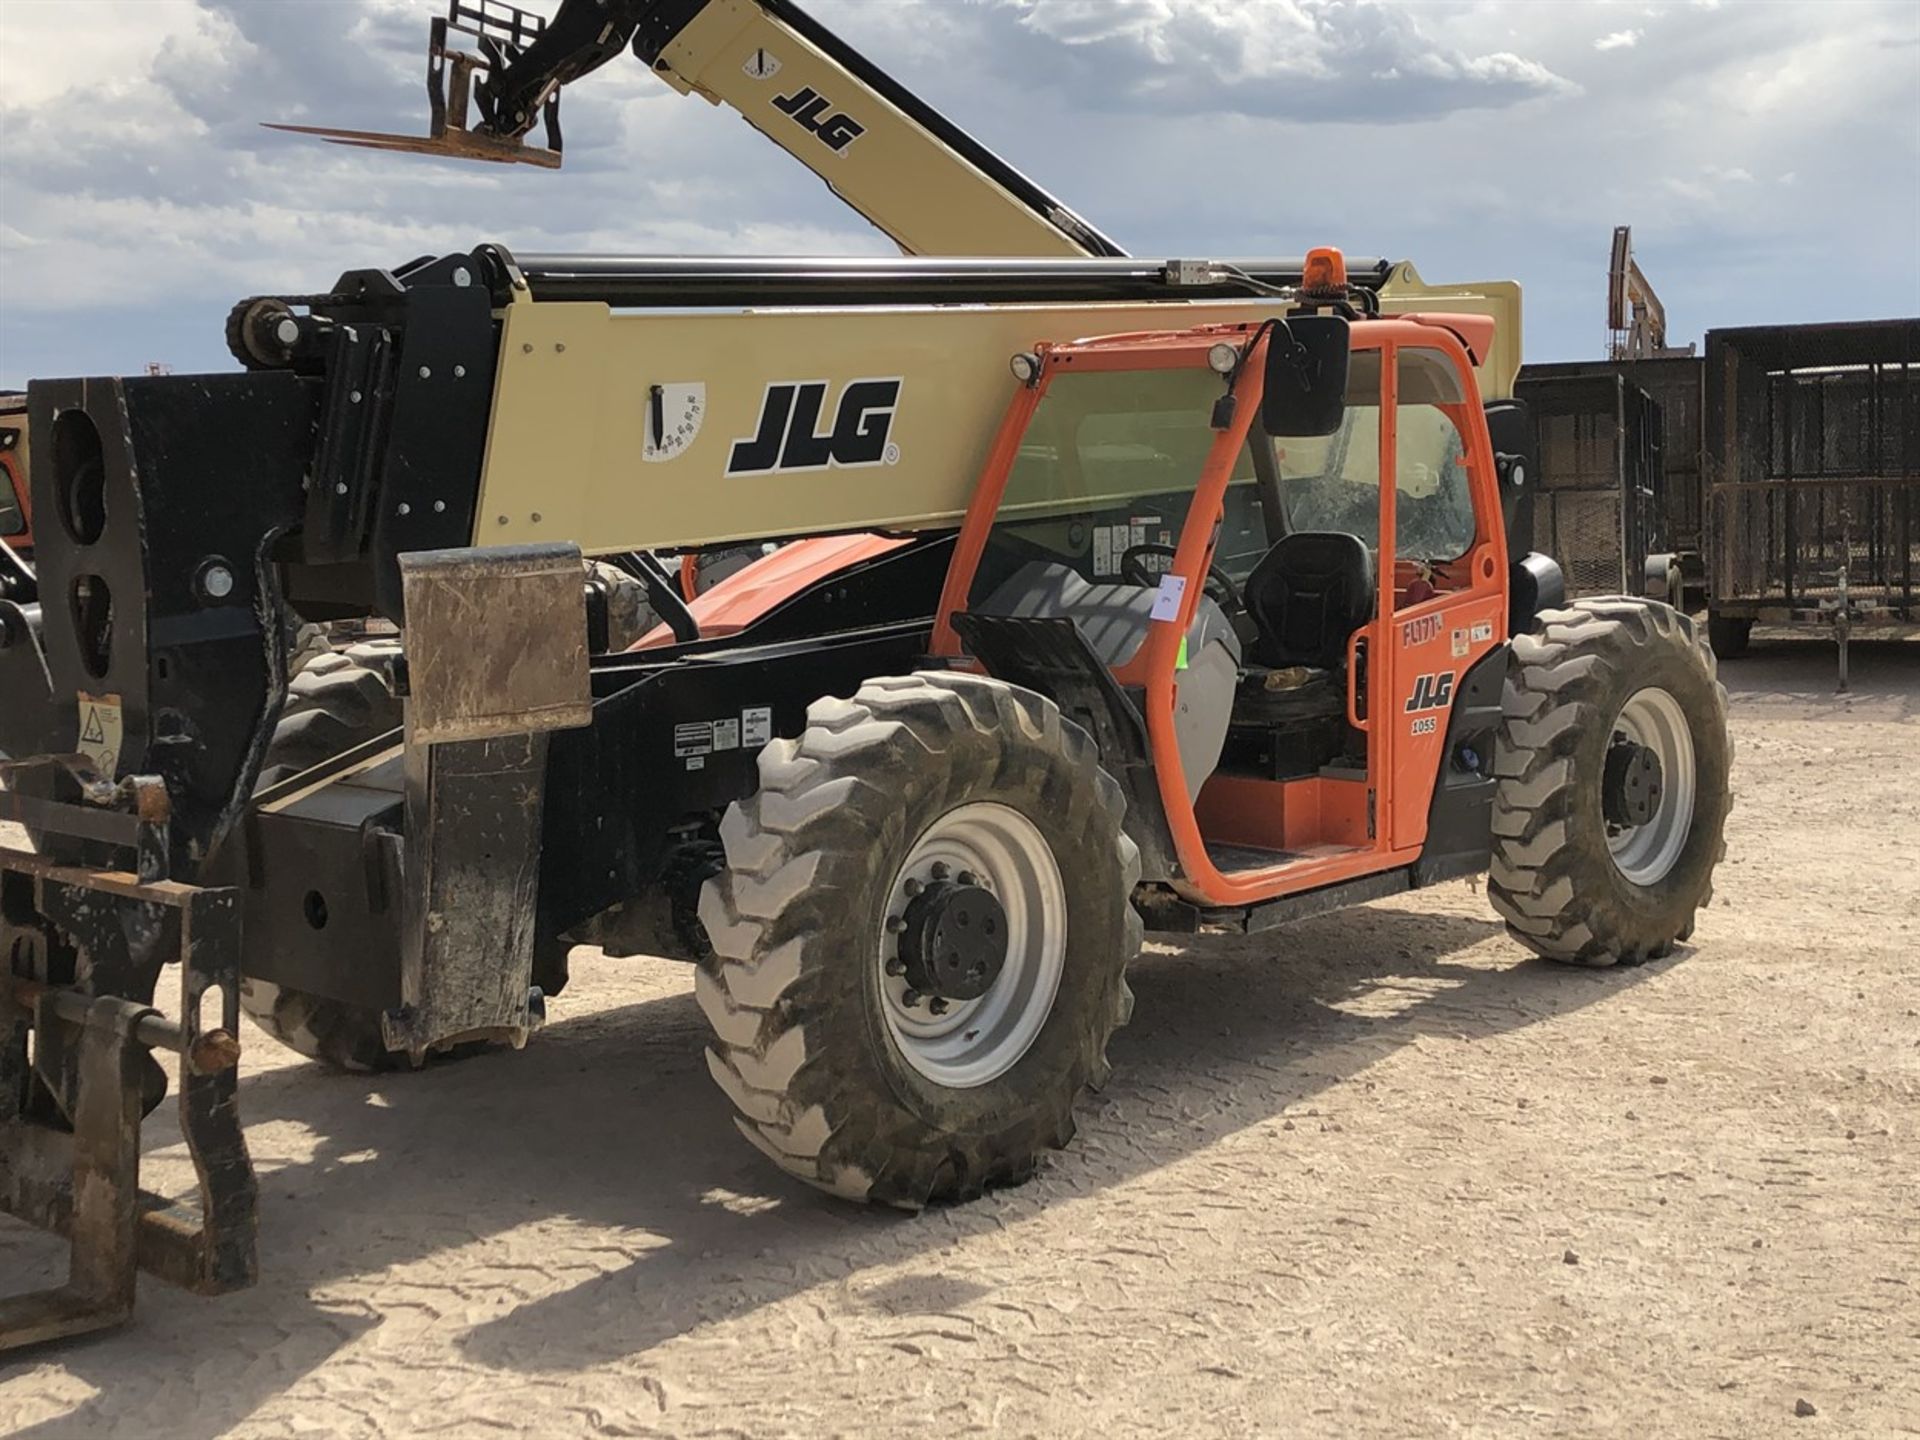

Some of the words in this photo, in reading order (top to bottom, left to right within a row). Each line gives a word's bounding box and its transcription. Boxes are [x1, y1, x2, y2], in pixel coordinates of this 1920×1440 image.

[770, 86, 866, 152] JLG
[726, 379, 902, 474] JLG
[1405, 671, 1455, 713] JLG
[1412, 717, 1436, 734] 1055
